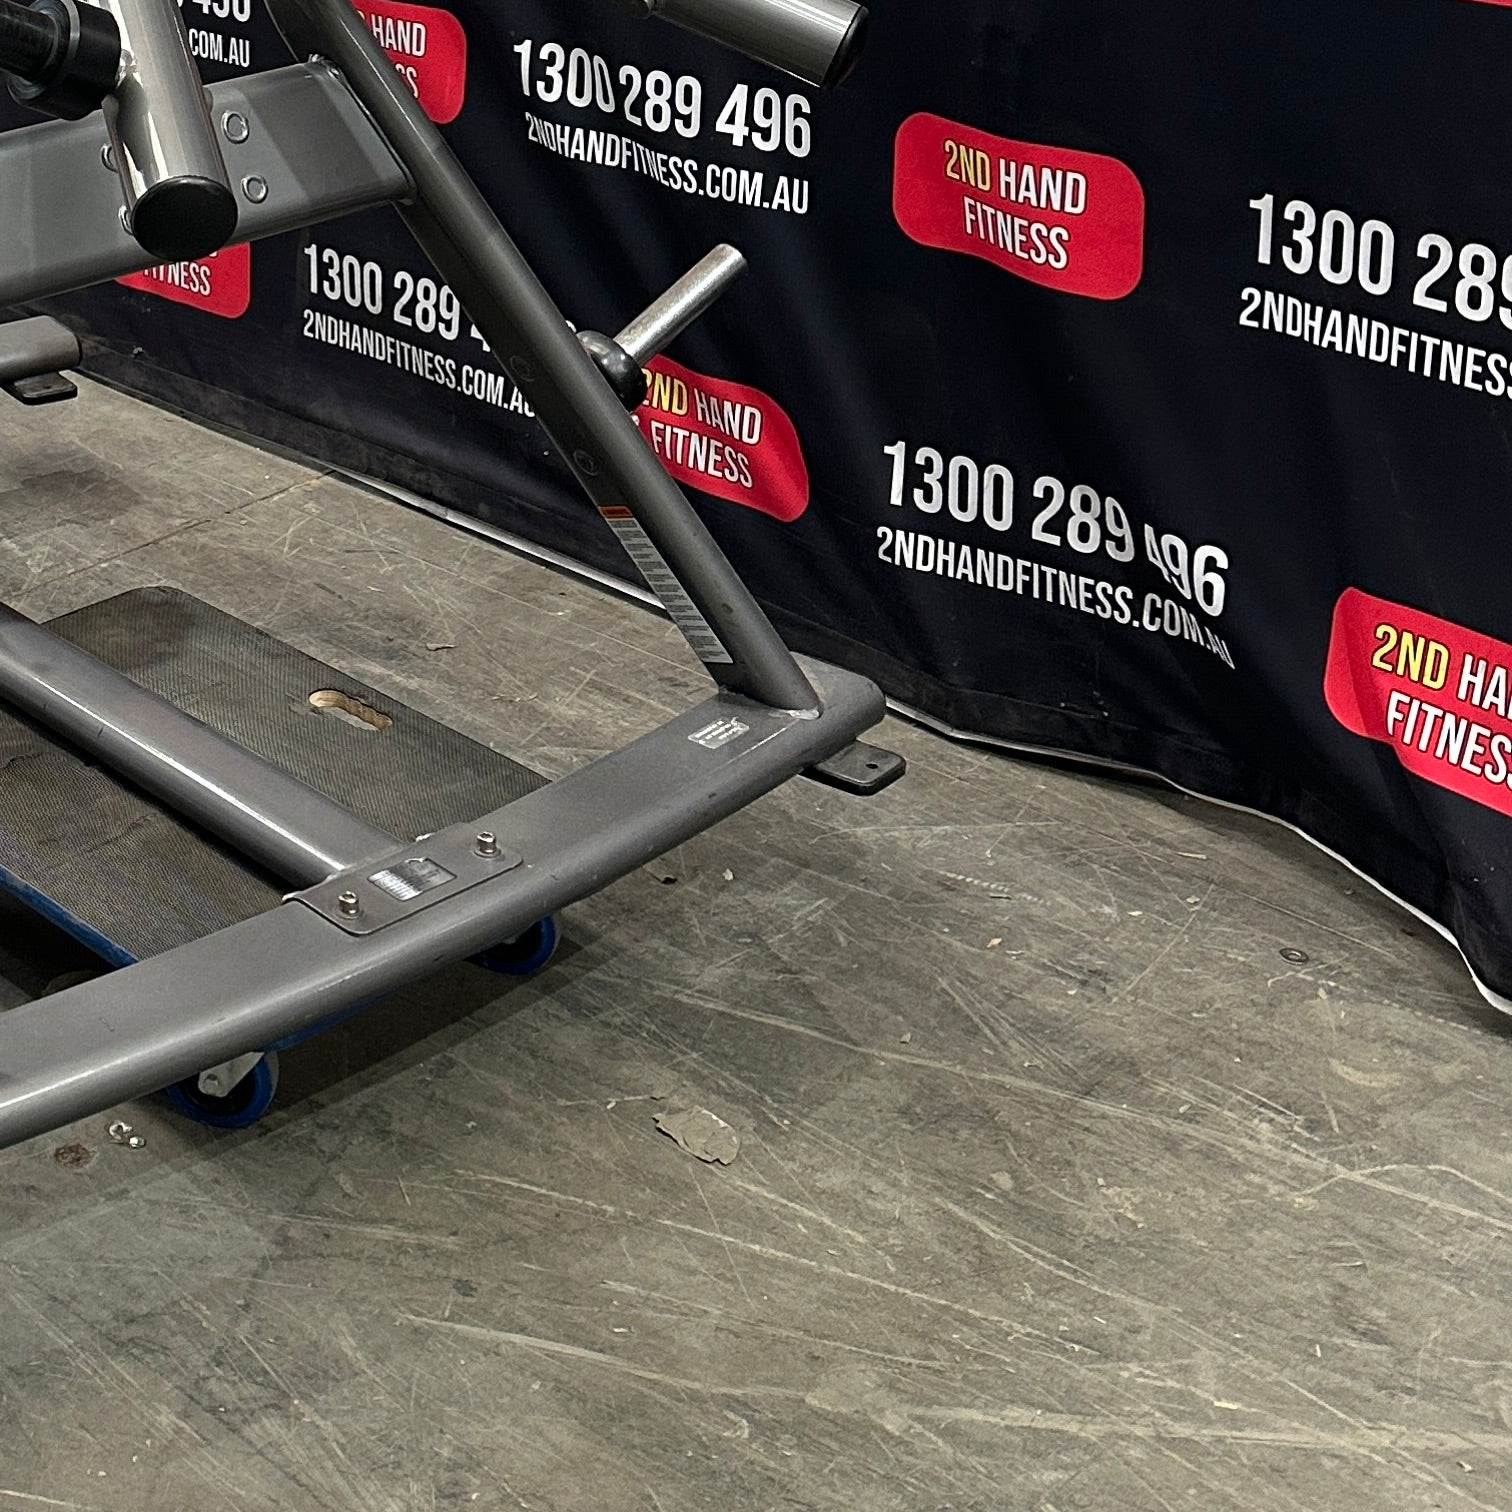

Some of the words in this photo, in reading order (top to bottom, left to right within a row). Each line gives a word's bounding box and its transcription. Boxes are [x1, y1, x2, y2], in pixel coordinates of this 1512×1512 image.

[372, 14, 426, 58] HAND
[513, 39, 616, 113] 1300
[618, 64, 702, 139] 289
[715, 83, 811, 158] 496
[525, 111, 809, 215] 2NDHANDFITNESS.COM.AU
[944, 139, 991, 191] 2ND
[999, 158, 1087, 214] HAND
[963, 196, 1069, 269] FITNESS
[1249, 193, 1395, 296] 1300
[303, 243, 383, 315] 1300
[393, 271, 460, 340] 289
[1238, 286, 1512, 401] 2NDHANDFITNES
[650, 419, 754, 489] FITNESS
[693, 388, 762, 445] HAND
[883, 440, 1014, 532] 1300
[1031, 475, 1135, 563] 289
[1144, 523, 1229, 617] 496
[1372, 624, 1449, 690] 2ND
[1457, 653, 1512, 718] HA
